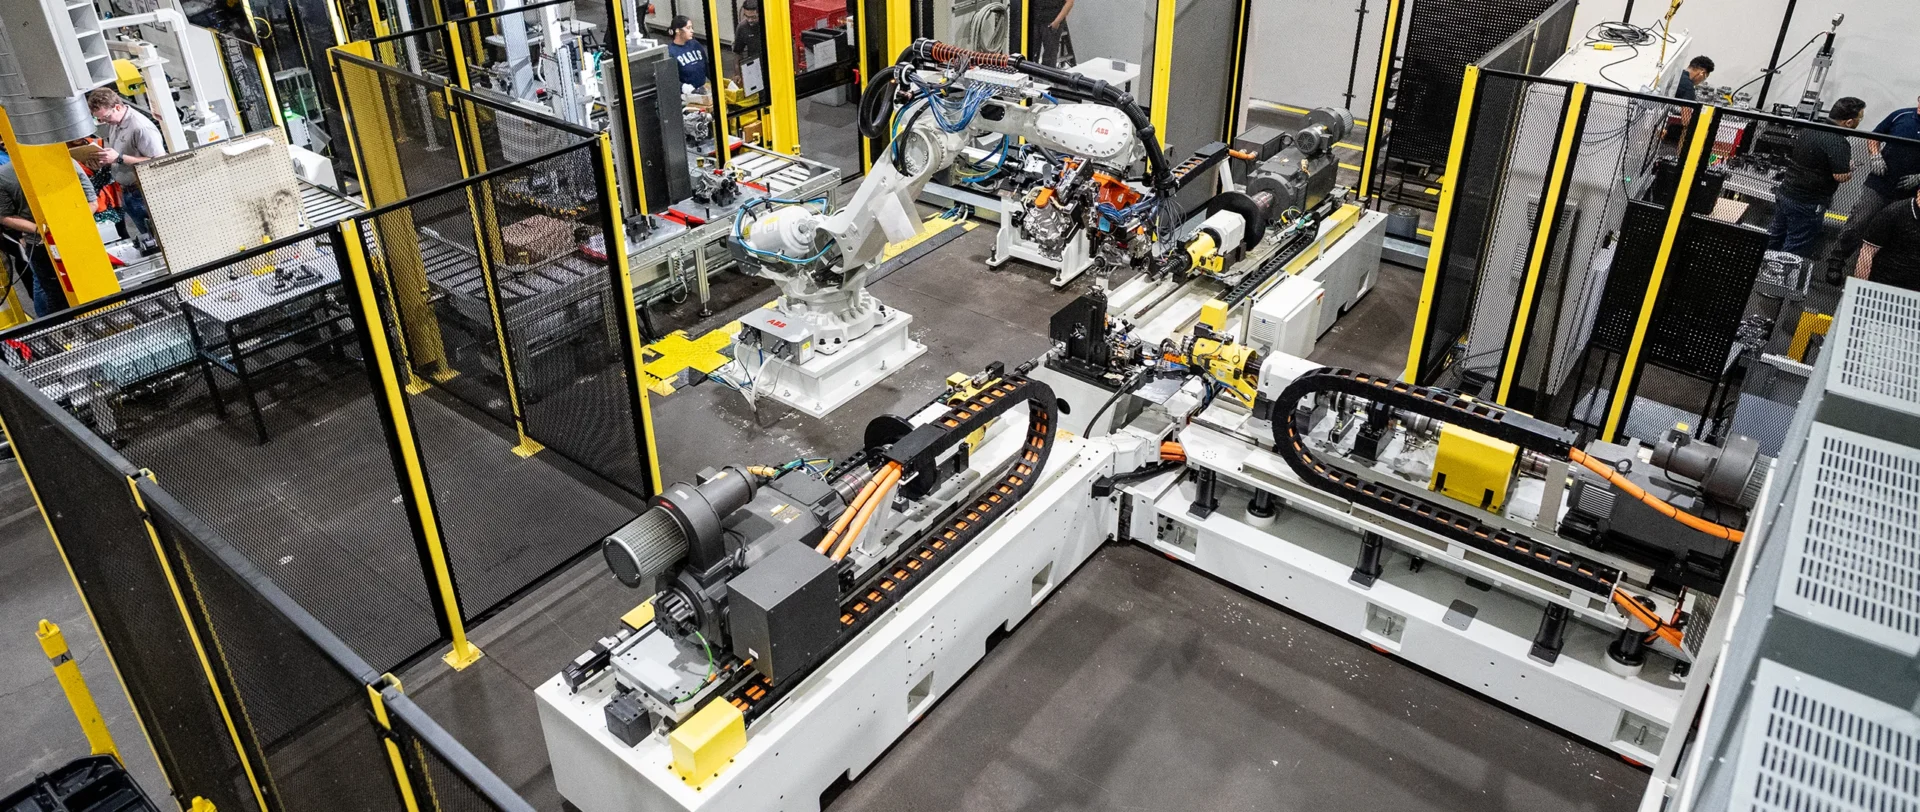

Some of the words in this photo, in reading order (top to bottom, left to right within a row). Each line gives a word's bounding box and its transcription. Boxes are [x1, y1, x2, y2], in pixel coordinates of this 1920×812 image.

[677, 50, 703, 66] PARIS
[1095, 127, 1109, 135] ABB
[767, 319, 787, 328] ABB
[61, 653, 70, 663] A
